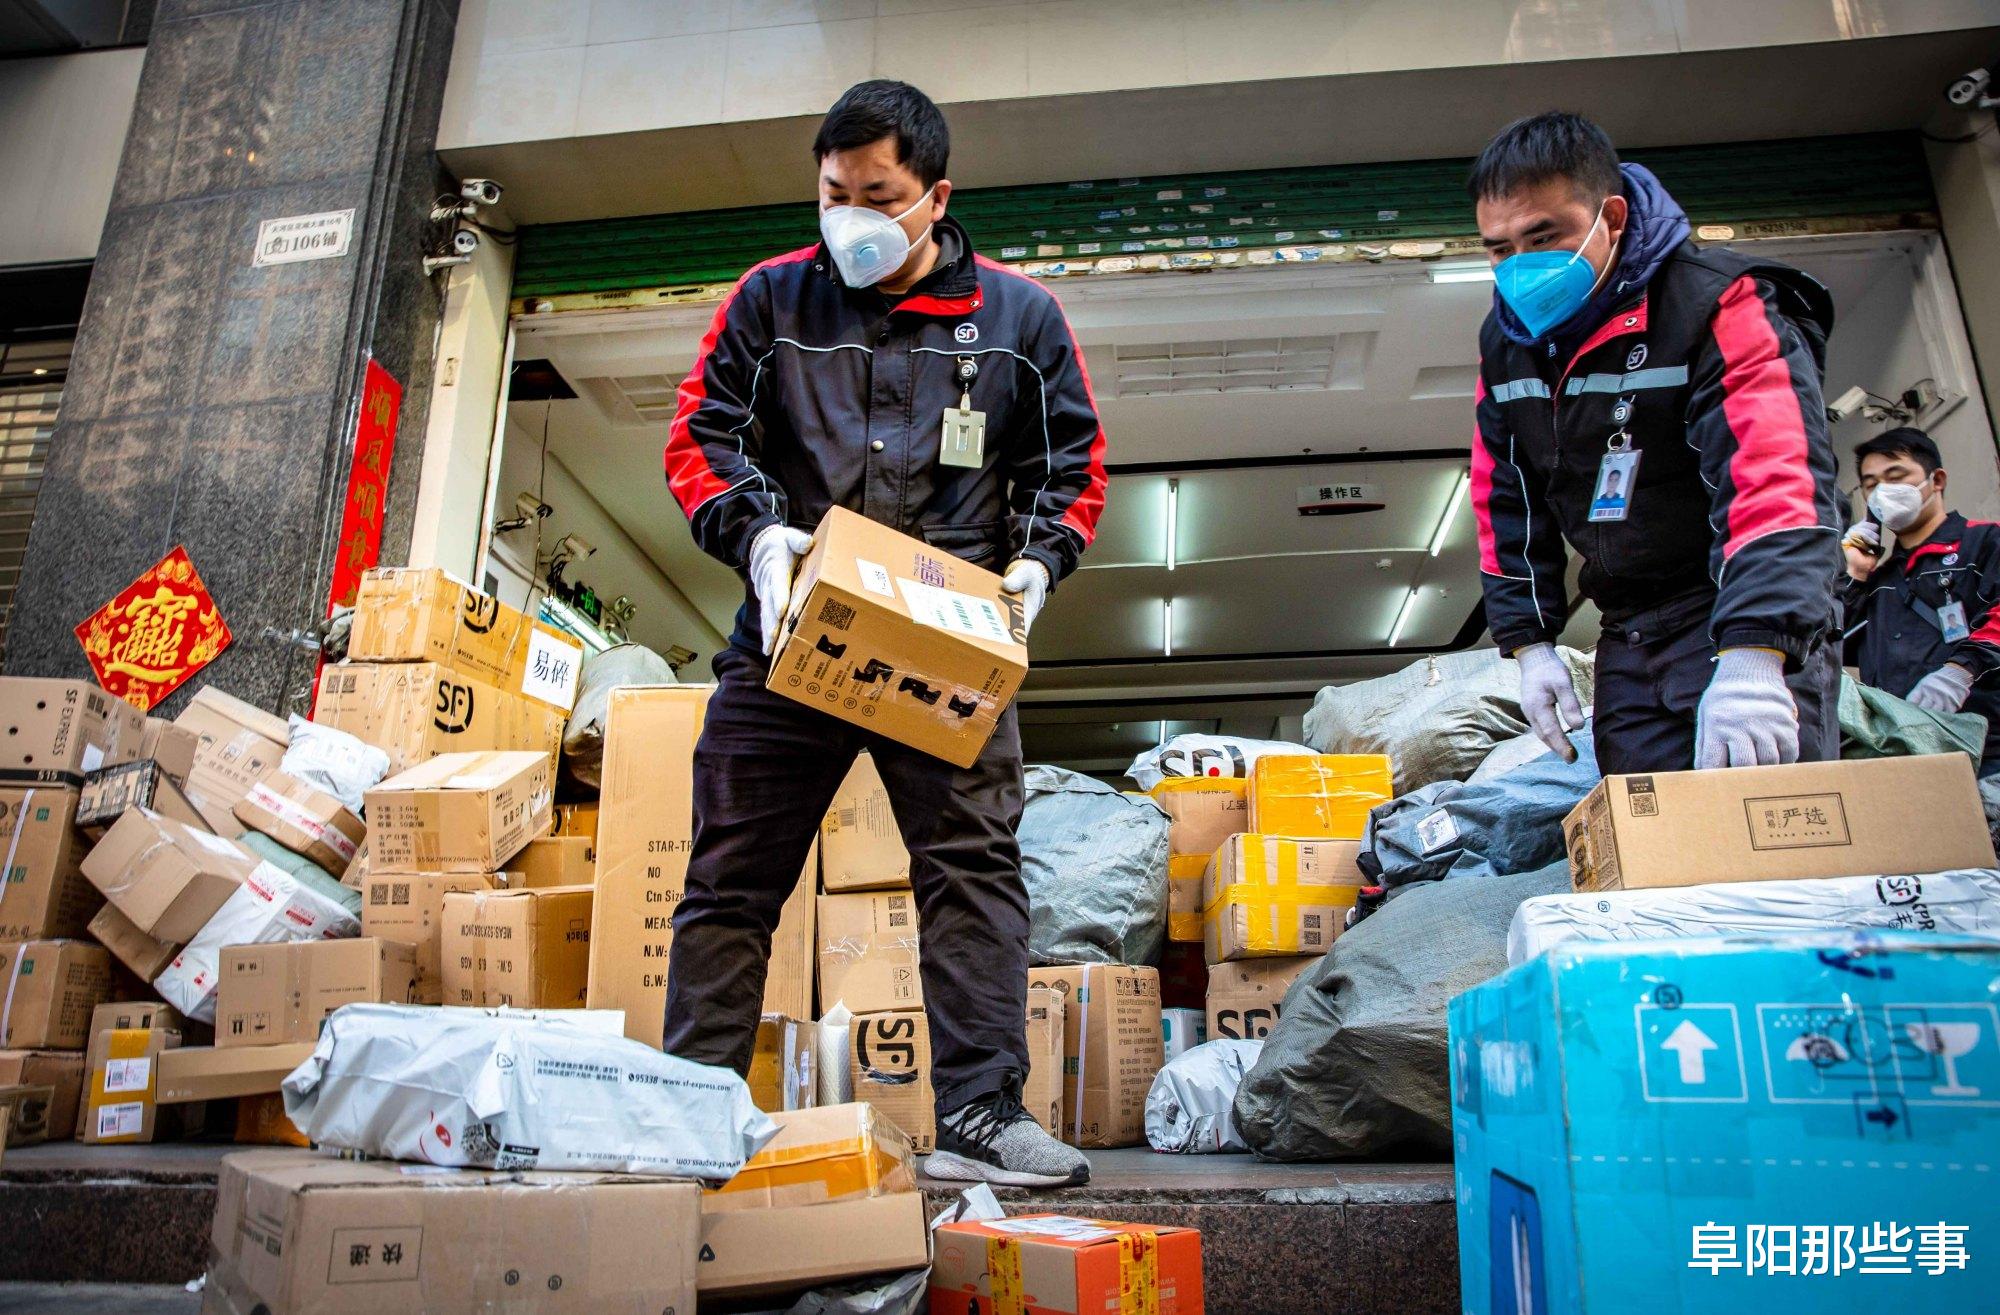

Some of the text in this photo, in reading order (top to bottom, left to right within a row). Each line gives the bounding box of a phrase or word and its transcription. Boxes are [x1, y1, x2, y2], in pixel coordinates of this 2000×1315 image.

[1319, 487, 1362, 500] 操作区
[533, 649, 570, 689] 易碎
[436, 679, 469, 722] SF
[1782, 807, 1828, 829] 严选
[648, 867, 661, 878] NO
[646, 889, 685, 903] Ctn Size
[645, 917, 673, 930] MEAS
[566, 931, 589, 943] Black
[644, 945, 667, 957] N.W:
[460, 956, 473, 970] KGS
[643, 974, 667, 987] G.W:
[460, 988, 473, 1001] KGS
[635, 1073, 658, 1085] 95338
[662, 1078, 731, 1092] www.sf-express.com
[350, 1242, 403, 1267] 快递
